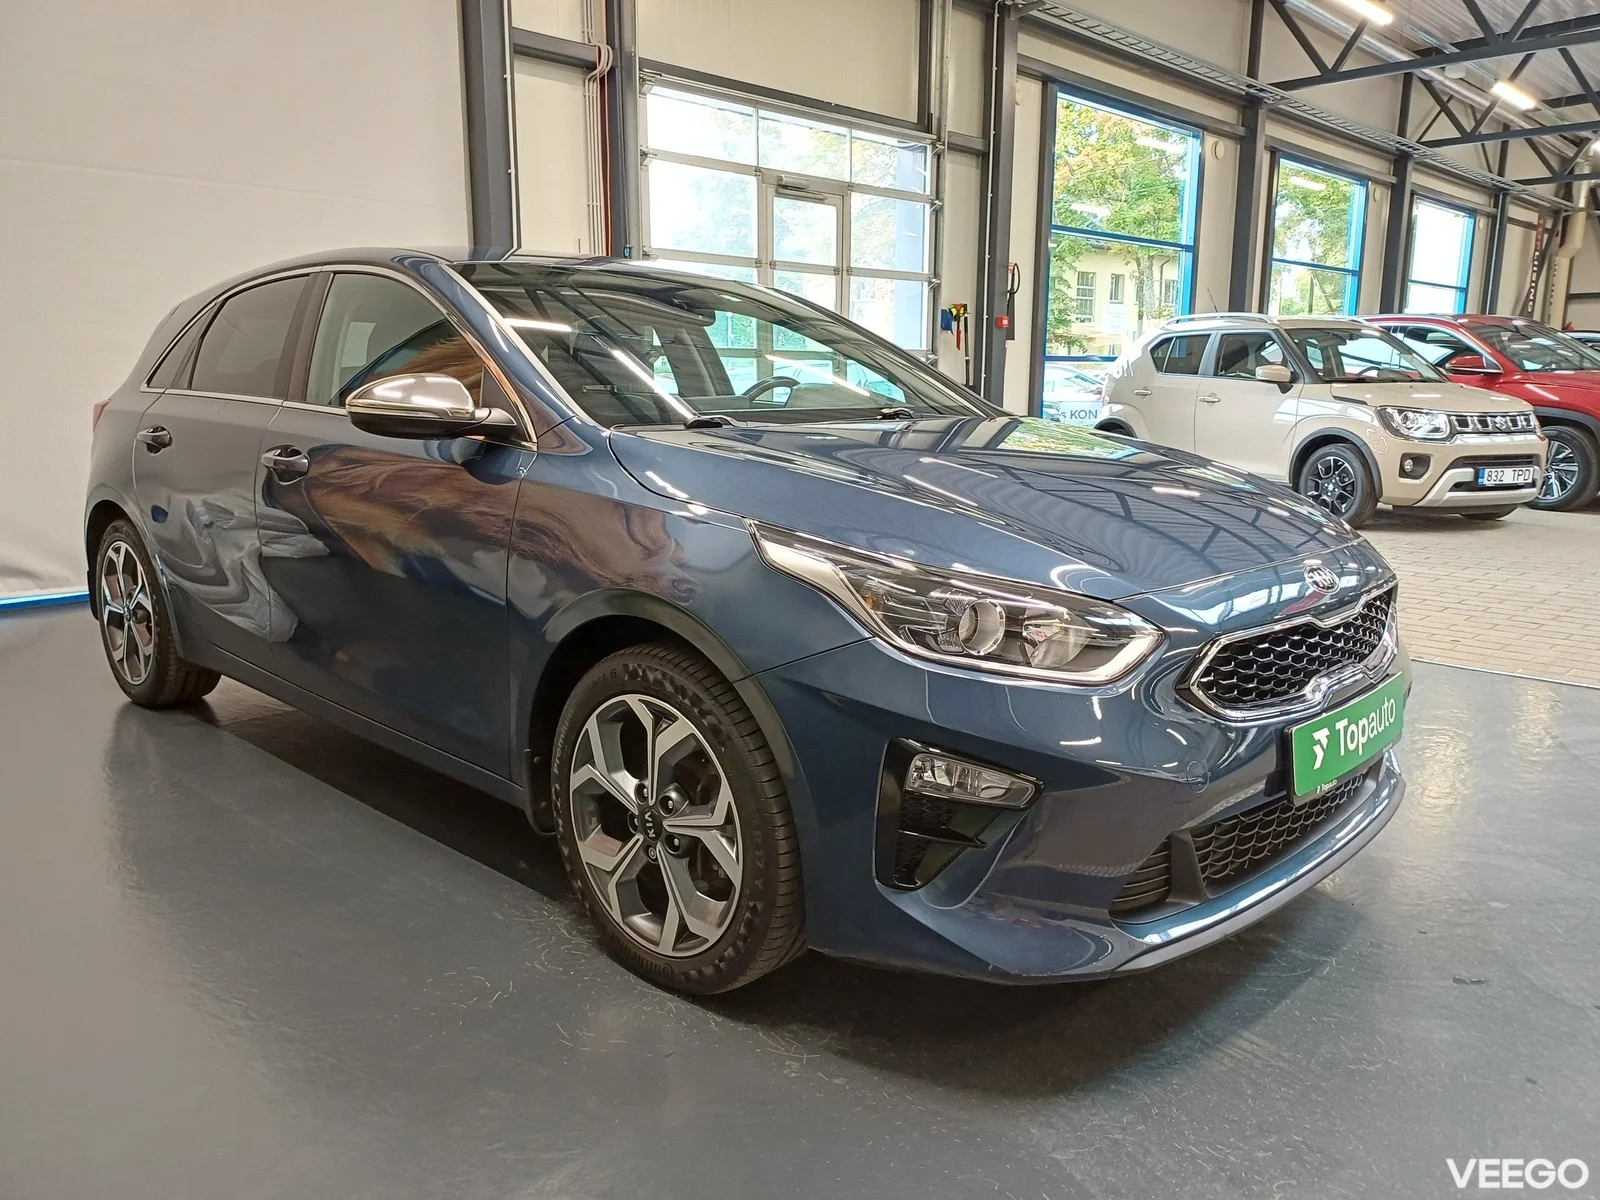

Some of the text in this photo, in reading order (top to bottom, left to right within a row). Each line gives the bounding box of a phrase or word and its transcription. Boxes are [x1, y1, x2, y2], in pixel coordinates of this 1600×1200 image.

[1486, 468, 1531, 482] 832 TPD
[1335, 696, 1397, 757] Topauto
[644, 810, 657, 838] KIA
